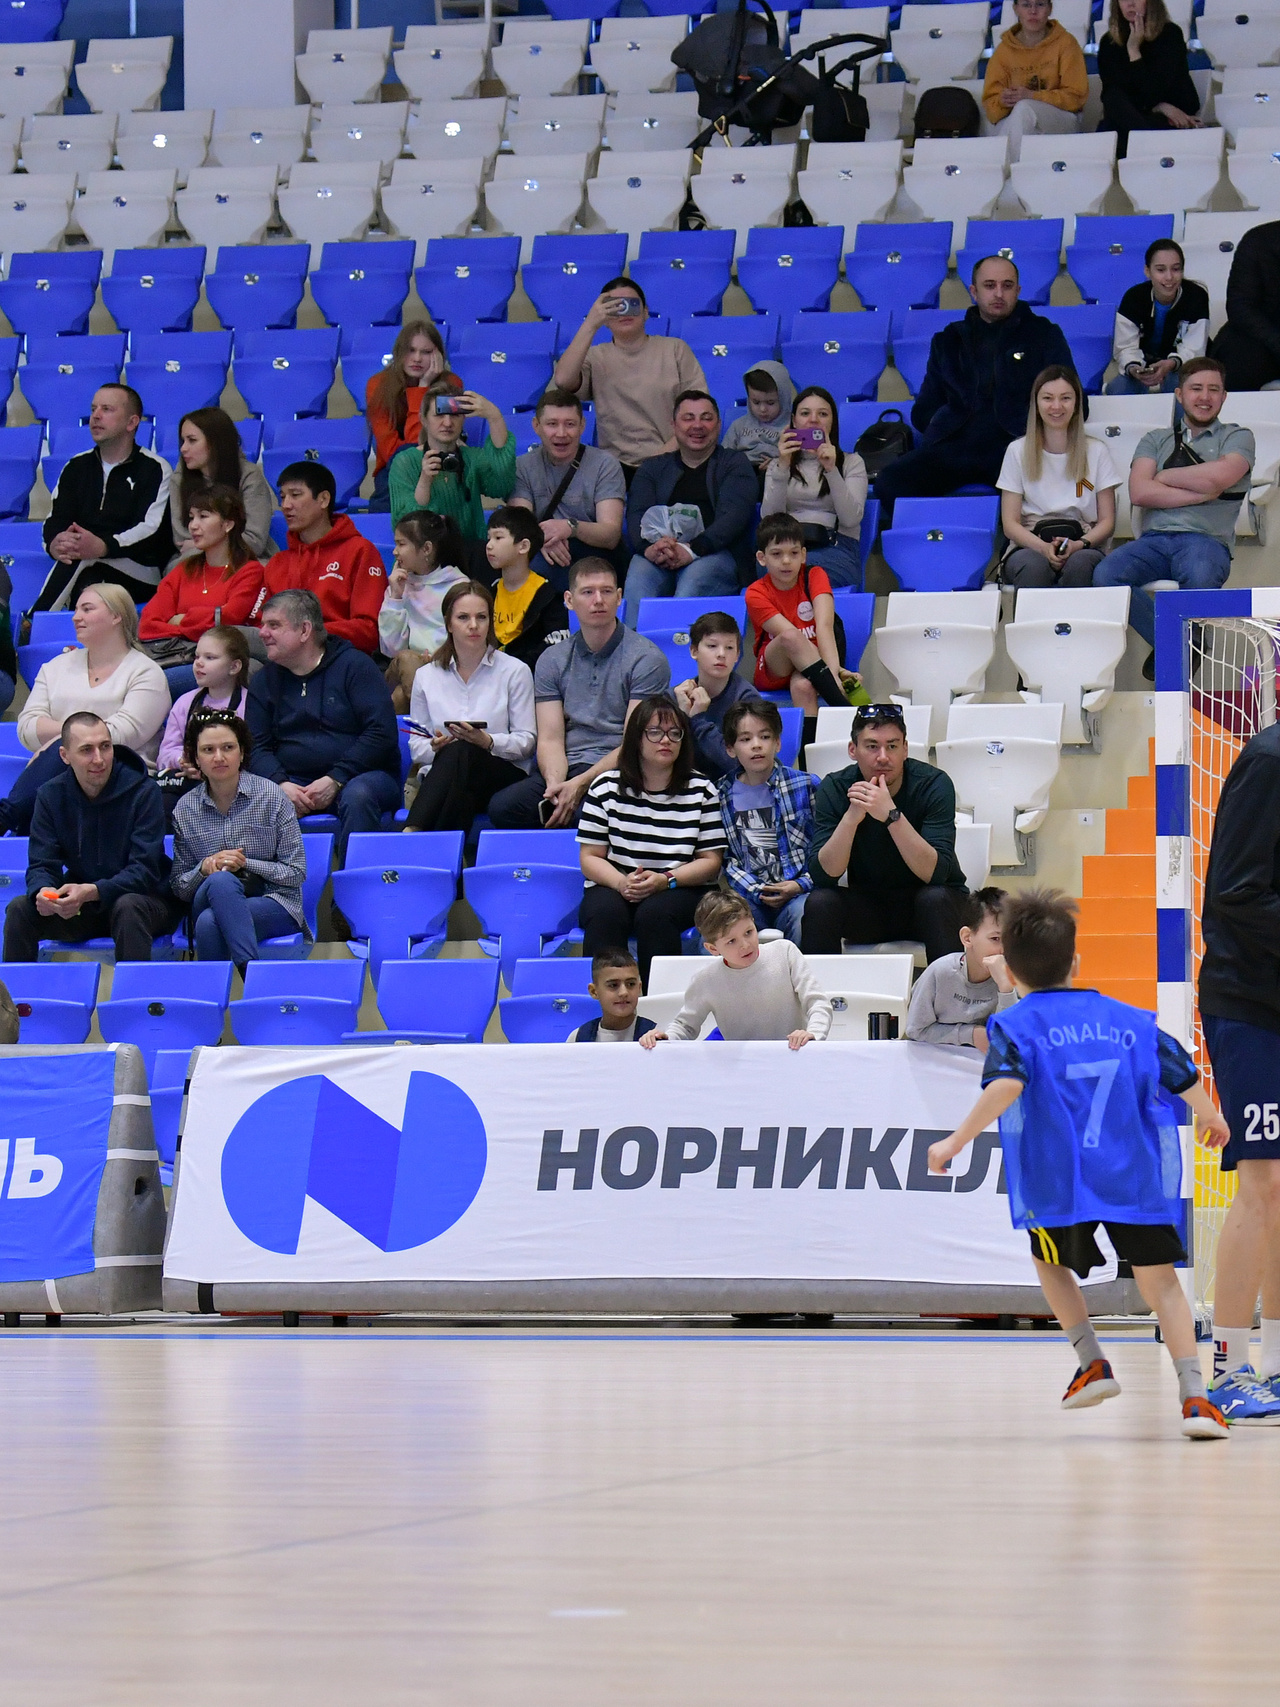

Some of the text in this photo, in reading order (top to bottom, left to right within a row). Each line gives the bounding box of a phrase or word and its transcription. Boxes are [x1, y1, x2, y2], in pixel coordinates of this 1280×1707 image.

[1035, 1022, 1137, 1056] RONALDO
[1066, 1058, 1121, 1149] 7
[1243, 1102, 1280, 1141] 25
[1213, 1340, 1228, 1381] FILA
